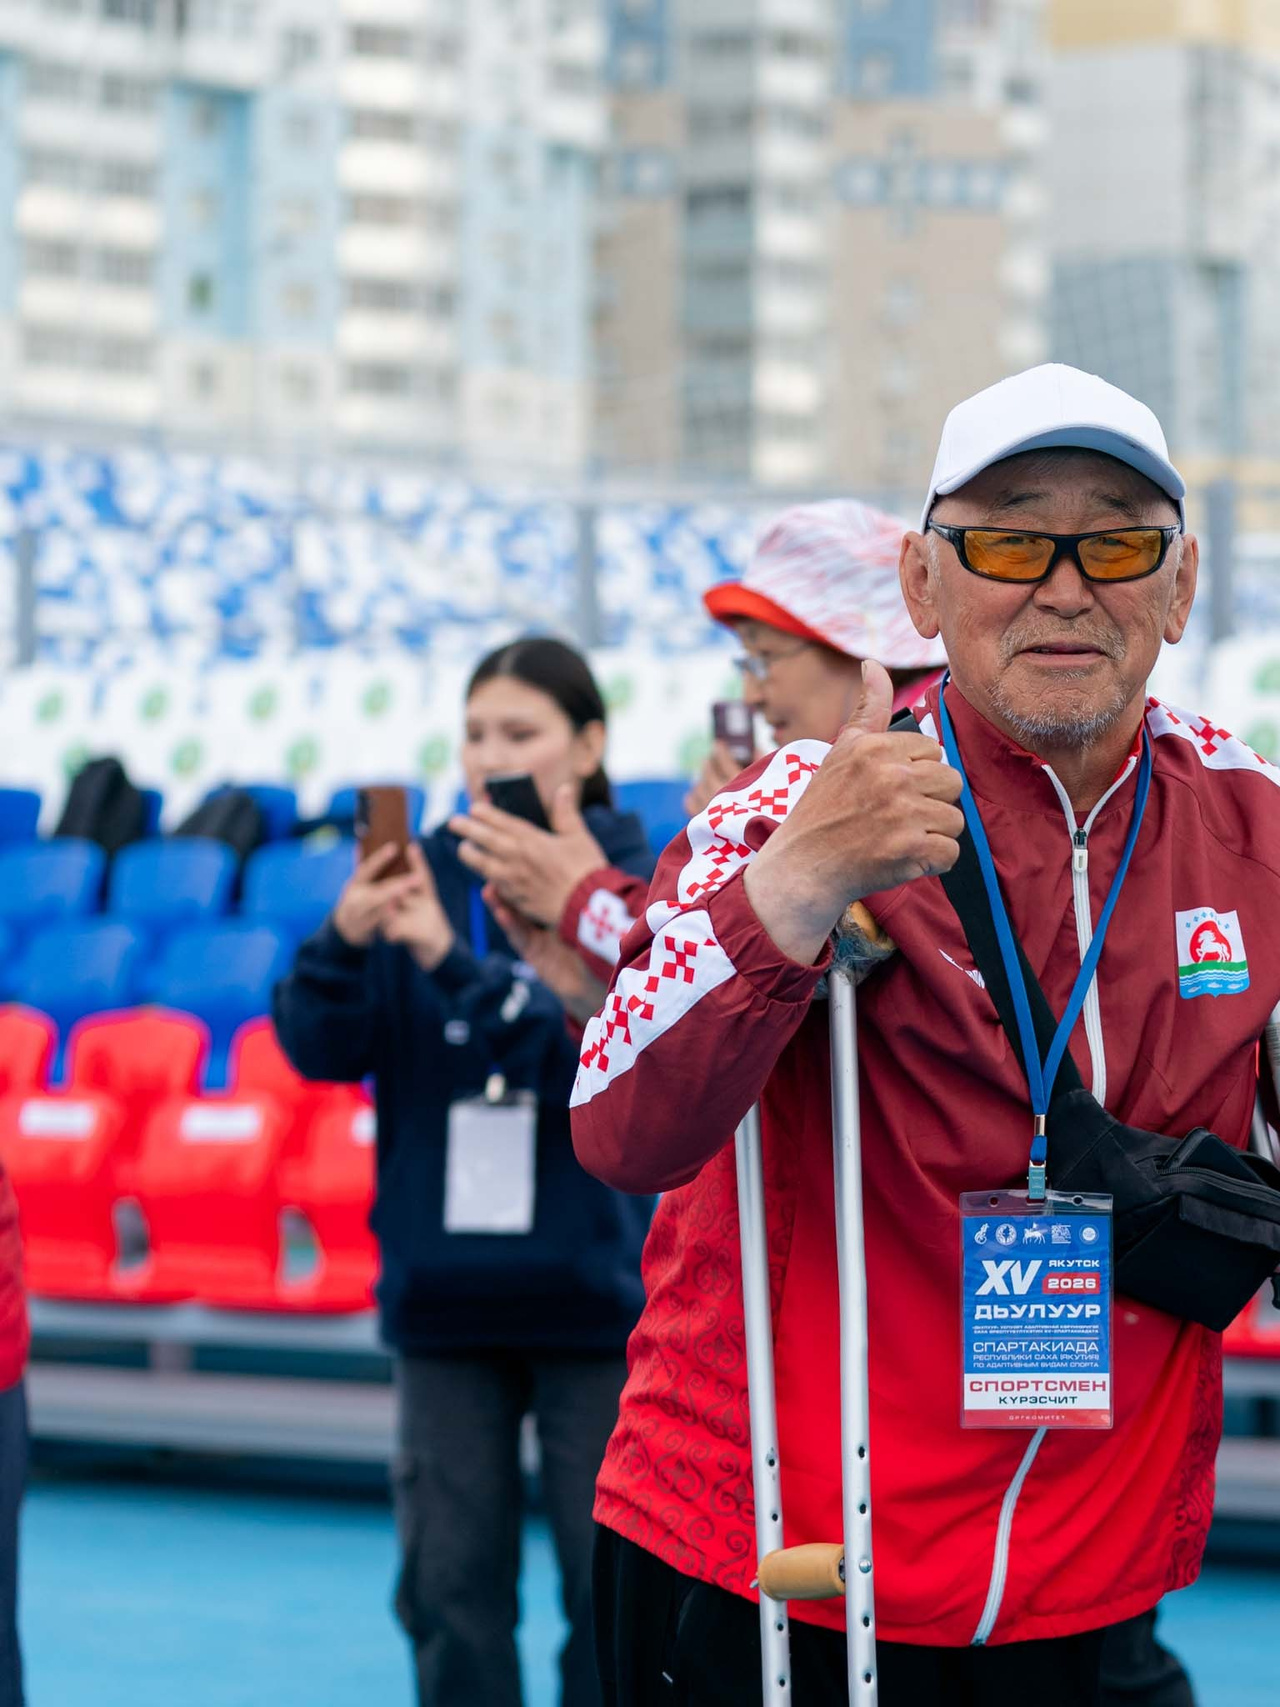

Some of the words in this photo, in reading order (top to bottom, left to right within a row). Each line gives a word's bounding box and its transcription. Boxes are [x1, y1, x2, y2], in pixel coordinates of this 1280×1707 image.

[1048, 1259, 1100, 1268] ЯКУТСК
[975, 1259, 1043, 1296] XV
[1047, 1278, 1096, 1289] 2026
[974, 1304, 1101, 1320] ДЬУЛУУР
[973, 1341, 1099, 1354] СПАРТАКИАДА
[969, 1380, 1106, 1392] СПОРТСМЕН
